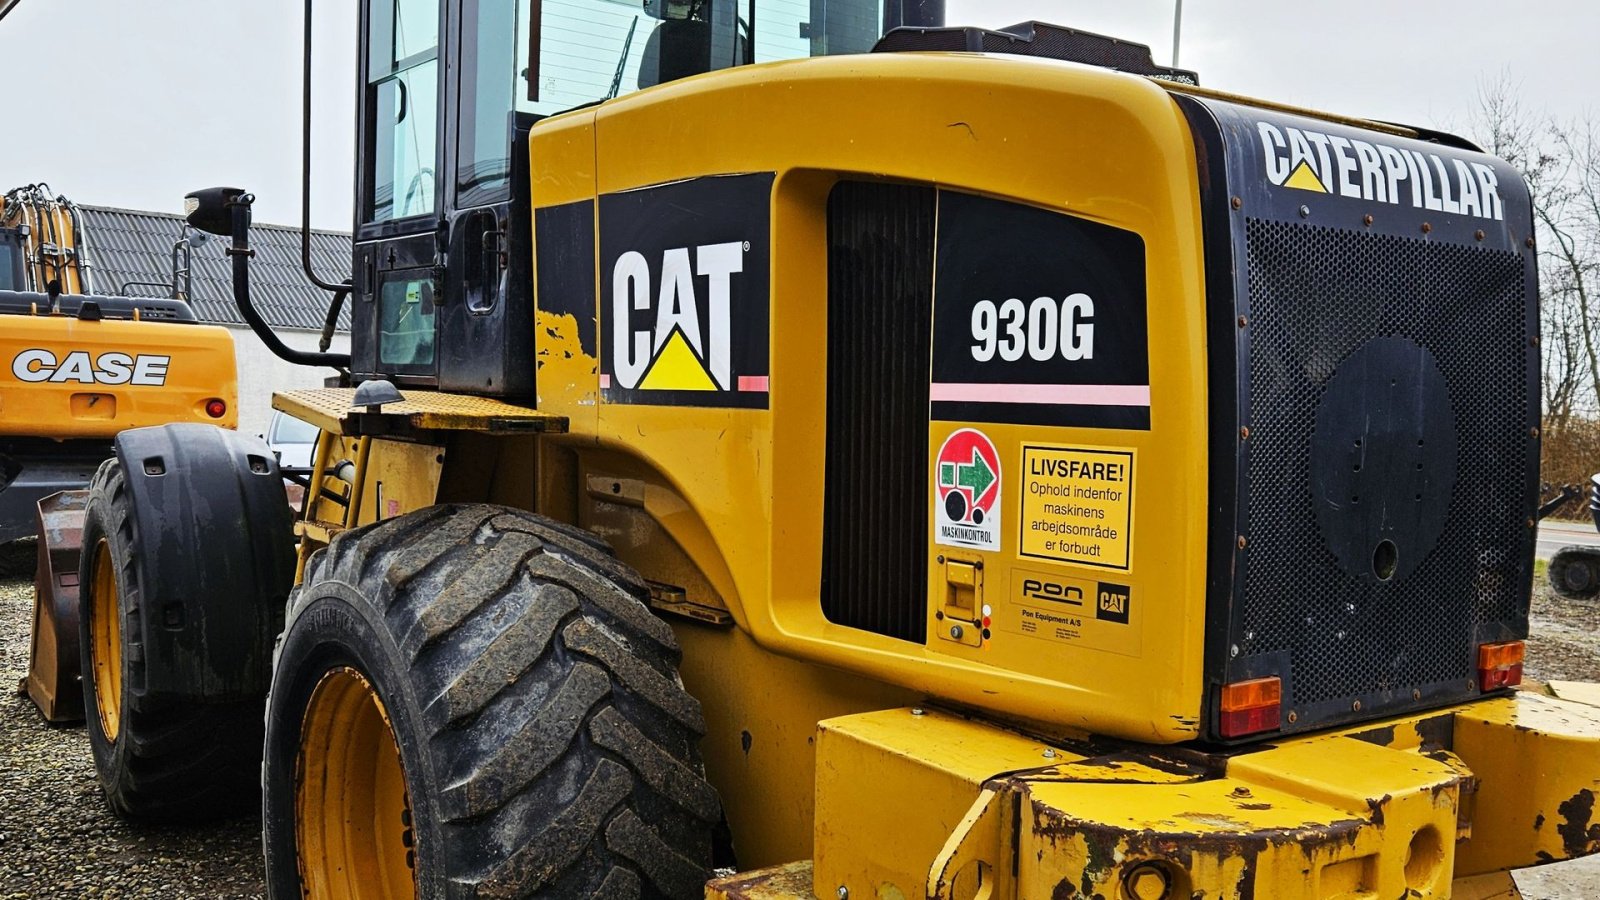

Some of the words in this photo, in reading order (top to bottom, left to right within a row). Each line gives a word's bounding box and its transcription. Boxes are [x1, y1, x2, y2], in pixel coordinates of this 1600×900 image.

[1257, 121, 1503, 221] CATERPILLAR
[971, 293, 1095, 362] 930G
[12, 348, 171, 386] CASE
[1031, 458, 1124, 482] LIVSFARE!
[1030, 481, 1071, 497] Ophold
[1074, 485, 1122, 501] indenfor
[1044, 503, 1105, 519] maskinens
[942, 525, 992, 543] MASKINKONTROL
[1031, 520, 1117, 539] arbejdsområde
[1045, 540, 1056, 550] er
[1059, 540, 1101, 556] forbudt
[1100, 591, 1127, 614] CAT
[1022, 609, 1034, 618] Pon
[1035, 611, 1069, 625] Equipment
[1069, 618, 1082, 627] A/S
